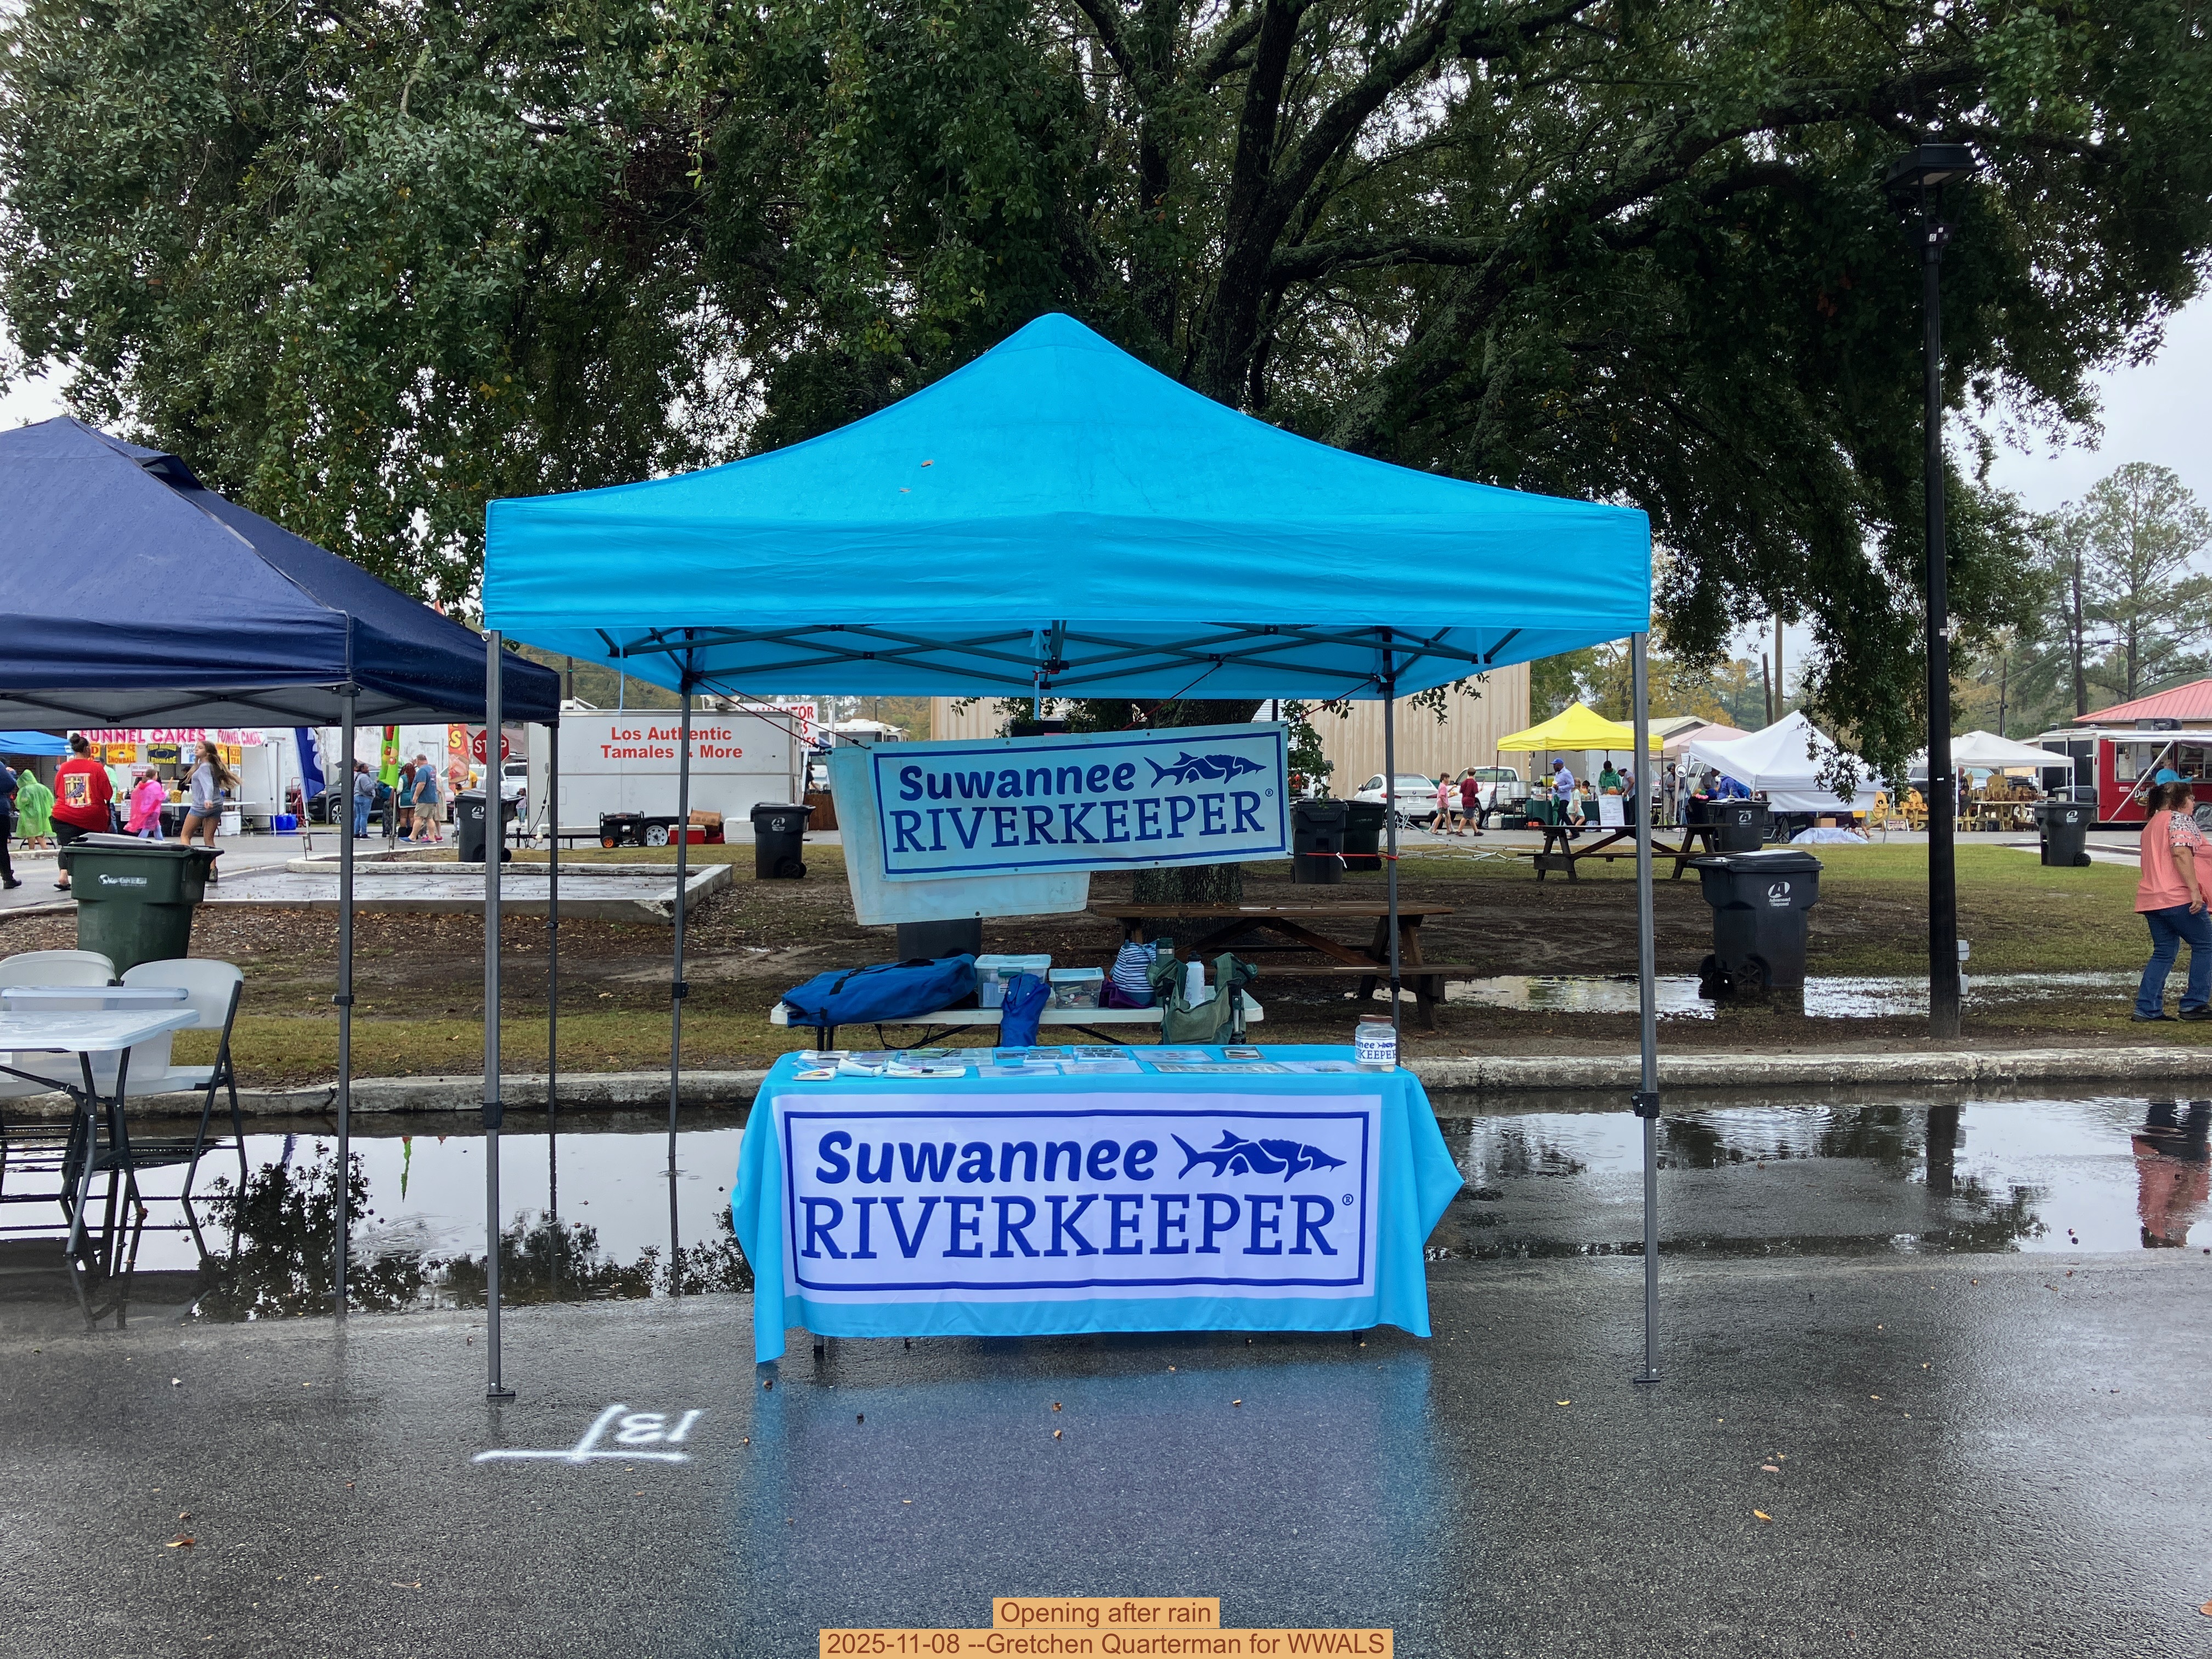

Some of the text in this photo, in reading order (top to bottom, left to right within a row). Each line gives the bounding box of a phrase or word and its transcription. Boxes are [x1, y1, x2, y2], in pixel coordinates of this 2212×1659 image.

[80, 729, 206, 743] FUNNEL CAKES
[218, 730, 240, 746] FUNNEL
[611, 727, 641, 740] Los
[107, 744, 136, 753] SHAVED ICE
[230, 748, 240, 757] ICED
[474, 740, 507, 753] SP
[601, 744, 674, 758] Tamales
[700, 744, 743, 758] More
[108, 755, 136, 764] SNOWBALL
[148, 755, 176, 764] LEMONADE
[900, 763, 1136, 801] Suwannee
[816, 1131, 1158, 1183] Suwannee
